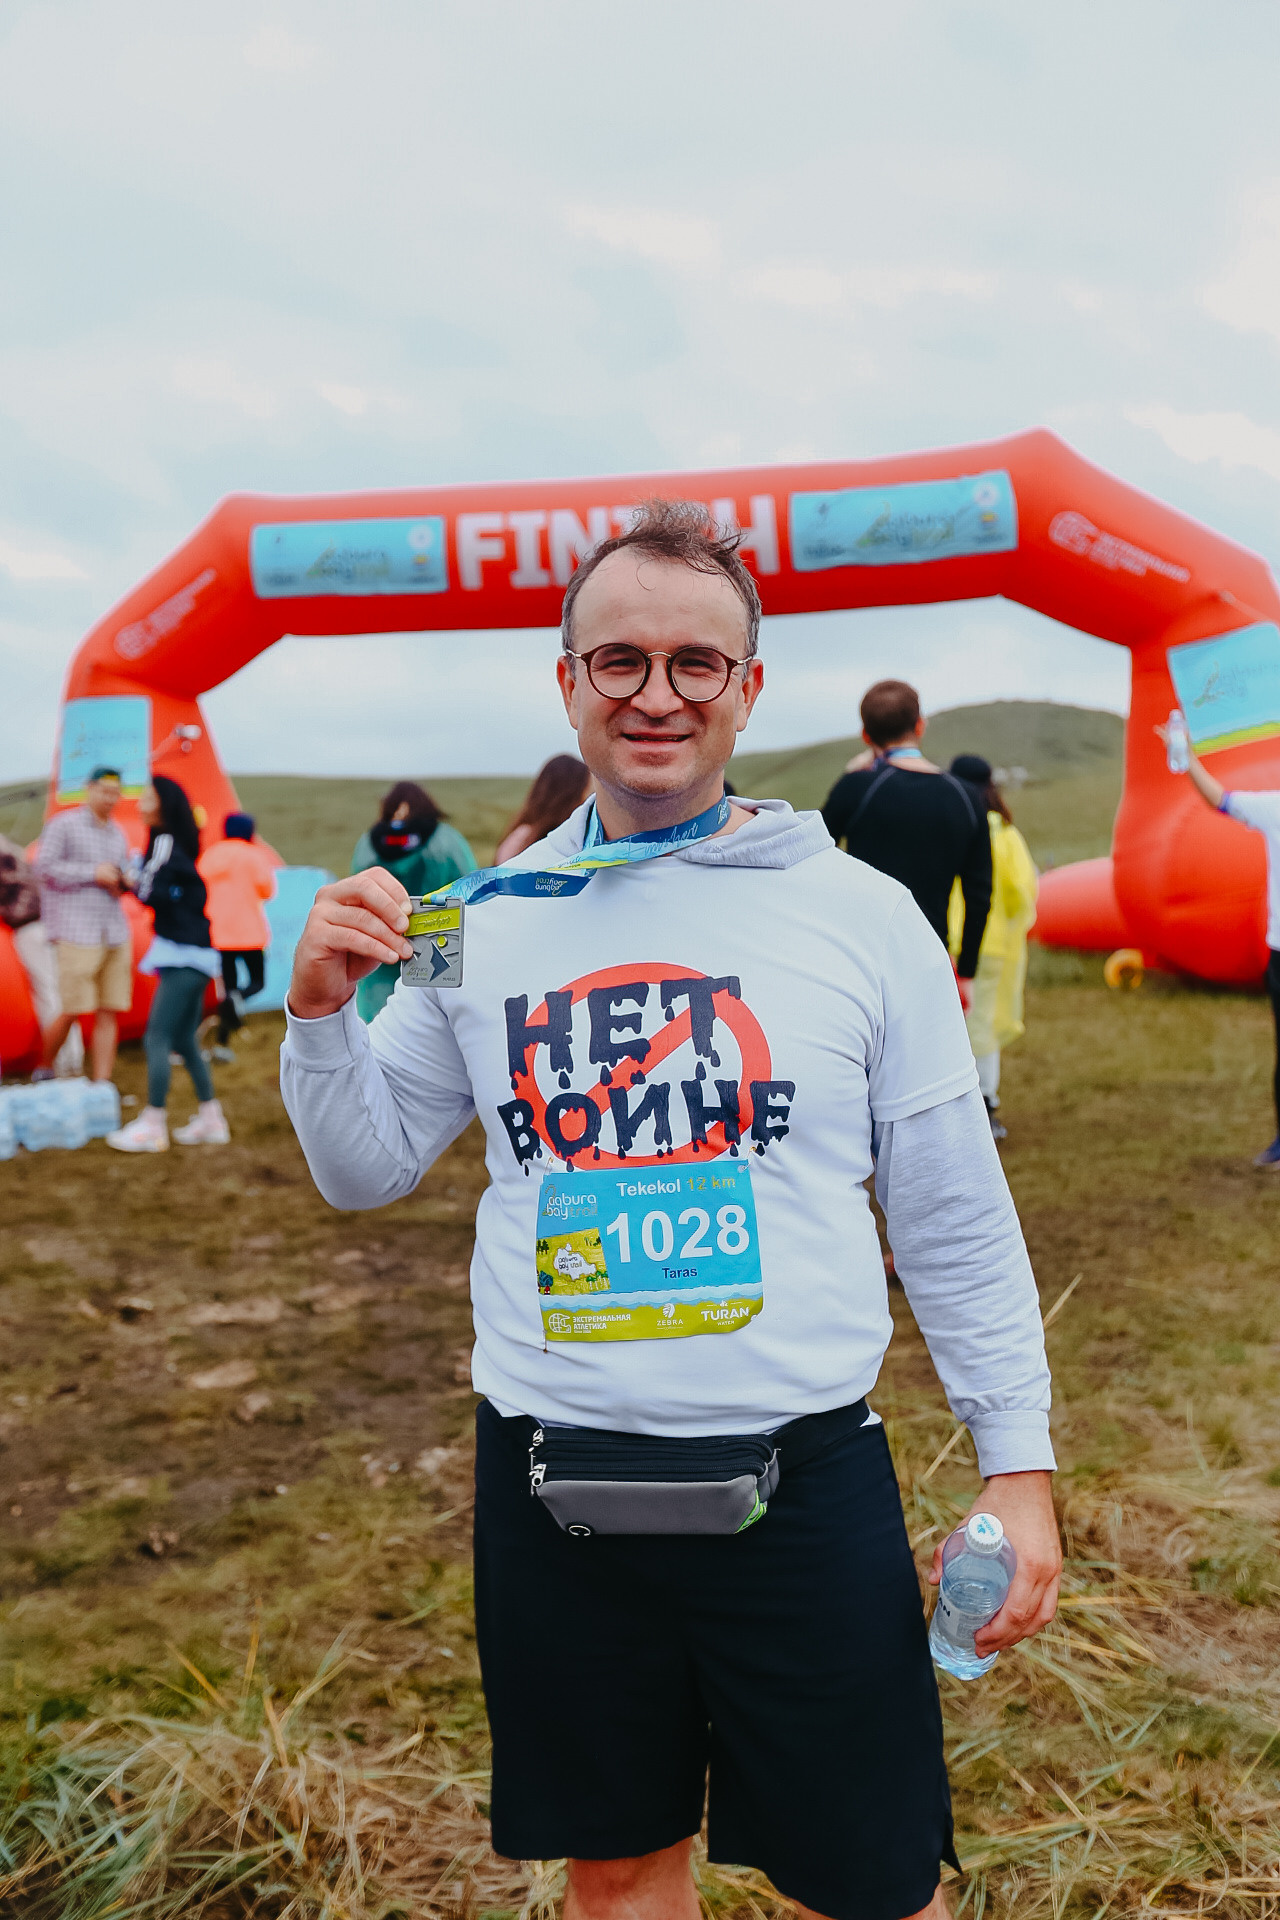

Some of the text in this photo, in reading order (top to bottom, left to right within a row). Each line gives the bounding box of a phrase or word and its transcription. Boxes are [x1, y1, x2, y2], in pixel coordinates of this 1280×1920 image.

[457, 494, 779, 590] FINH
[504, 976, 741, 1085] НЕТ
[615, 1175, 736, 1197] Tekekol 12 km
[606, 1204, 750, 1263] 1028
[661, 1266, 698, 1279] Taras
[572, 1313, 632, 1323] ЭКСТРЕМАЛЬНАЯ
[701, 1306, 750, 1321] TURAN
[573, 1322, 608, 1331] АТЛЕТИКА
[656, 1318, 684, 1327] ZEBRA
